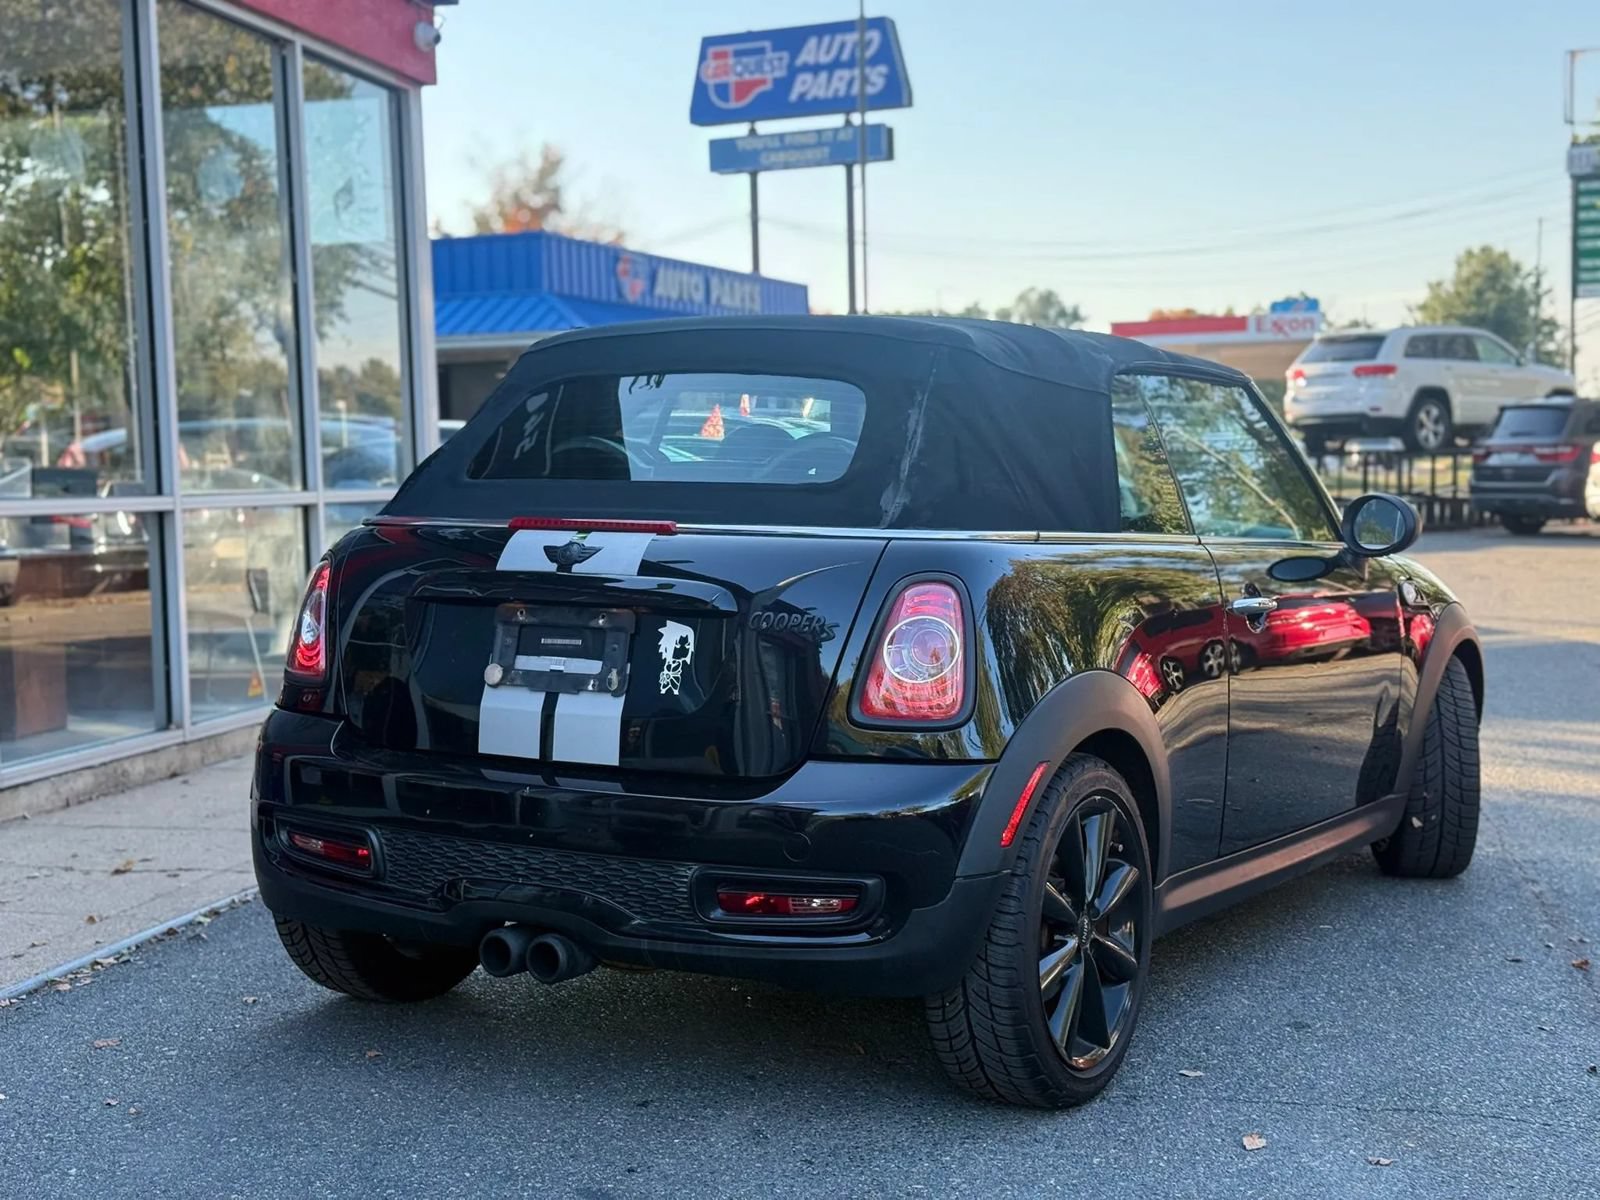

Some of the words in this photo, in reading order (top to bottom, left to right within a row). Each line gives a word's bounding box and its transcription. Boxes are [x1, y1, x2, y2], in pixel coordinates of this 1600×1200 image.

[796, 30, 881, 66] AUTO
[789, 66, 889, 103] PARTS
[654, 264, 705, 305] AUTO
[709, 273, 761, 314] PARTS
[1255, 315, 1316, 338] Exxon
[750, 611, 827, 631] COOPER
